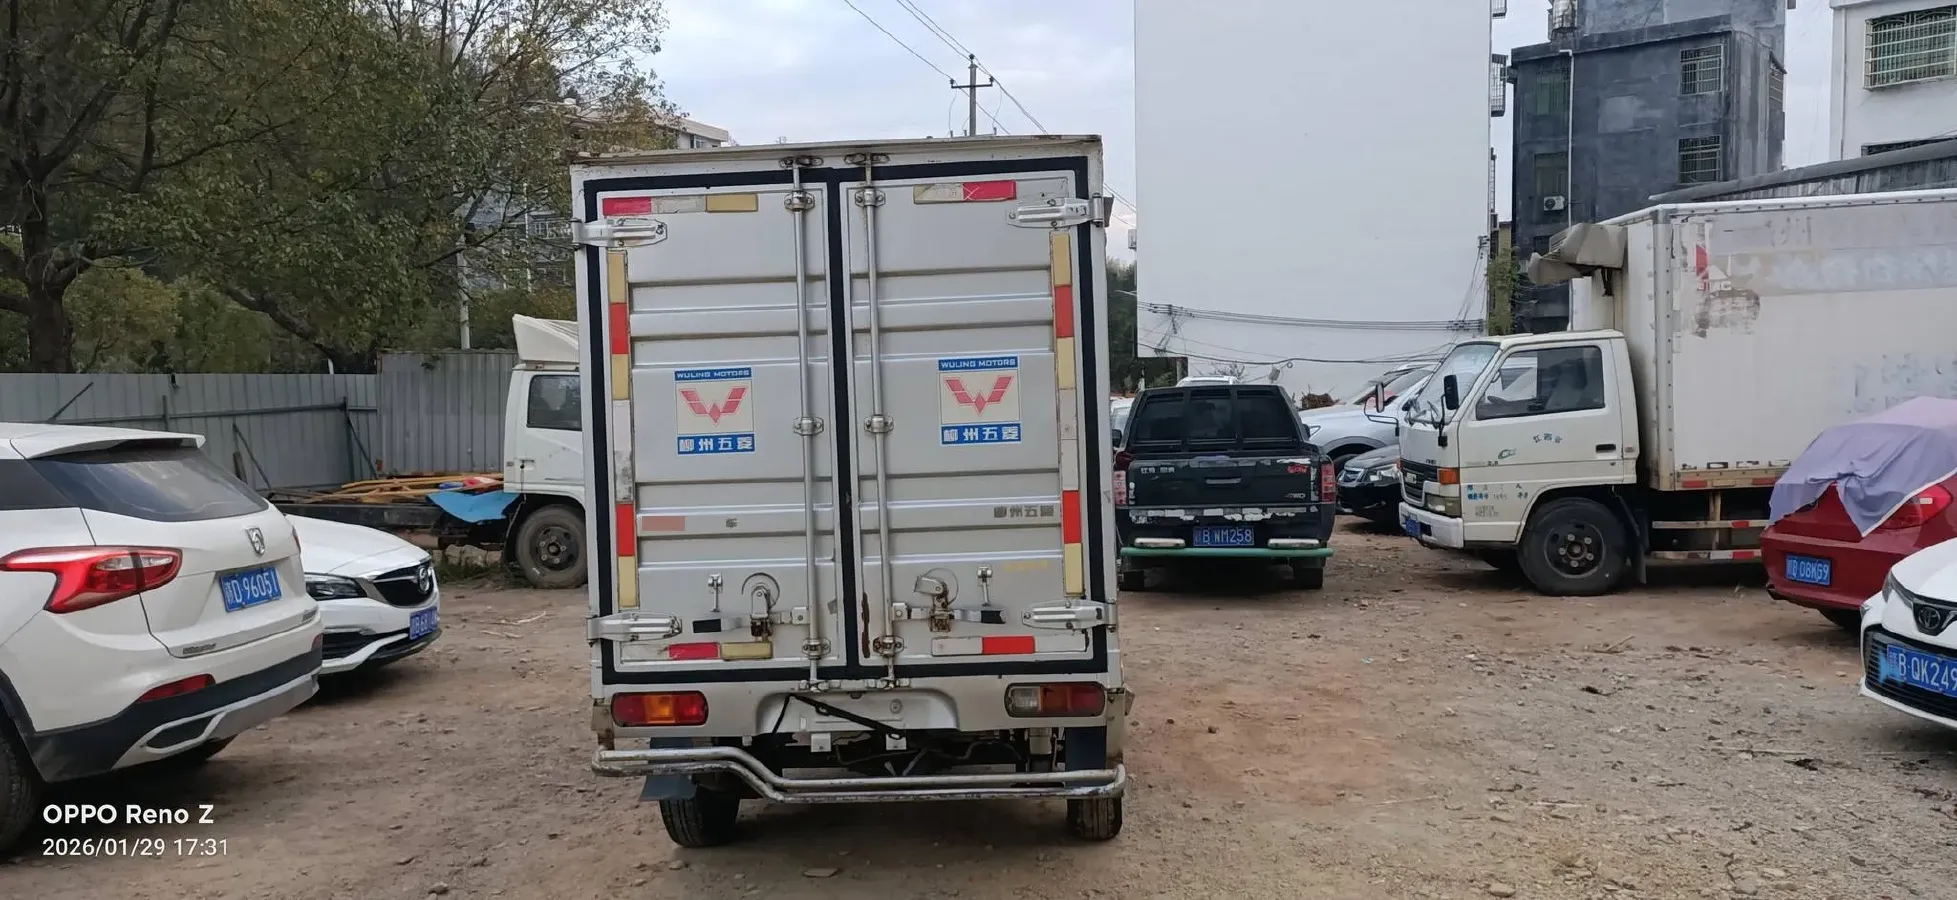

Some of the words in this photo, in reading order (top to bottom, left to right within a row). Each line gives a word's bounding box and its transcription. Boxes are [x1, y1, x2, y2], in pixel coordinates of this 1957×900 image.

[943, 426, 1019, 442] 柳州五菱
[679, 436, 753, 452] 柳州五菱
